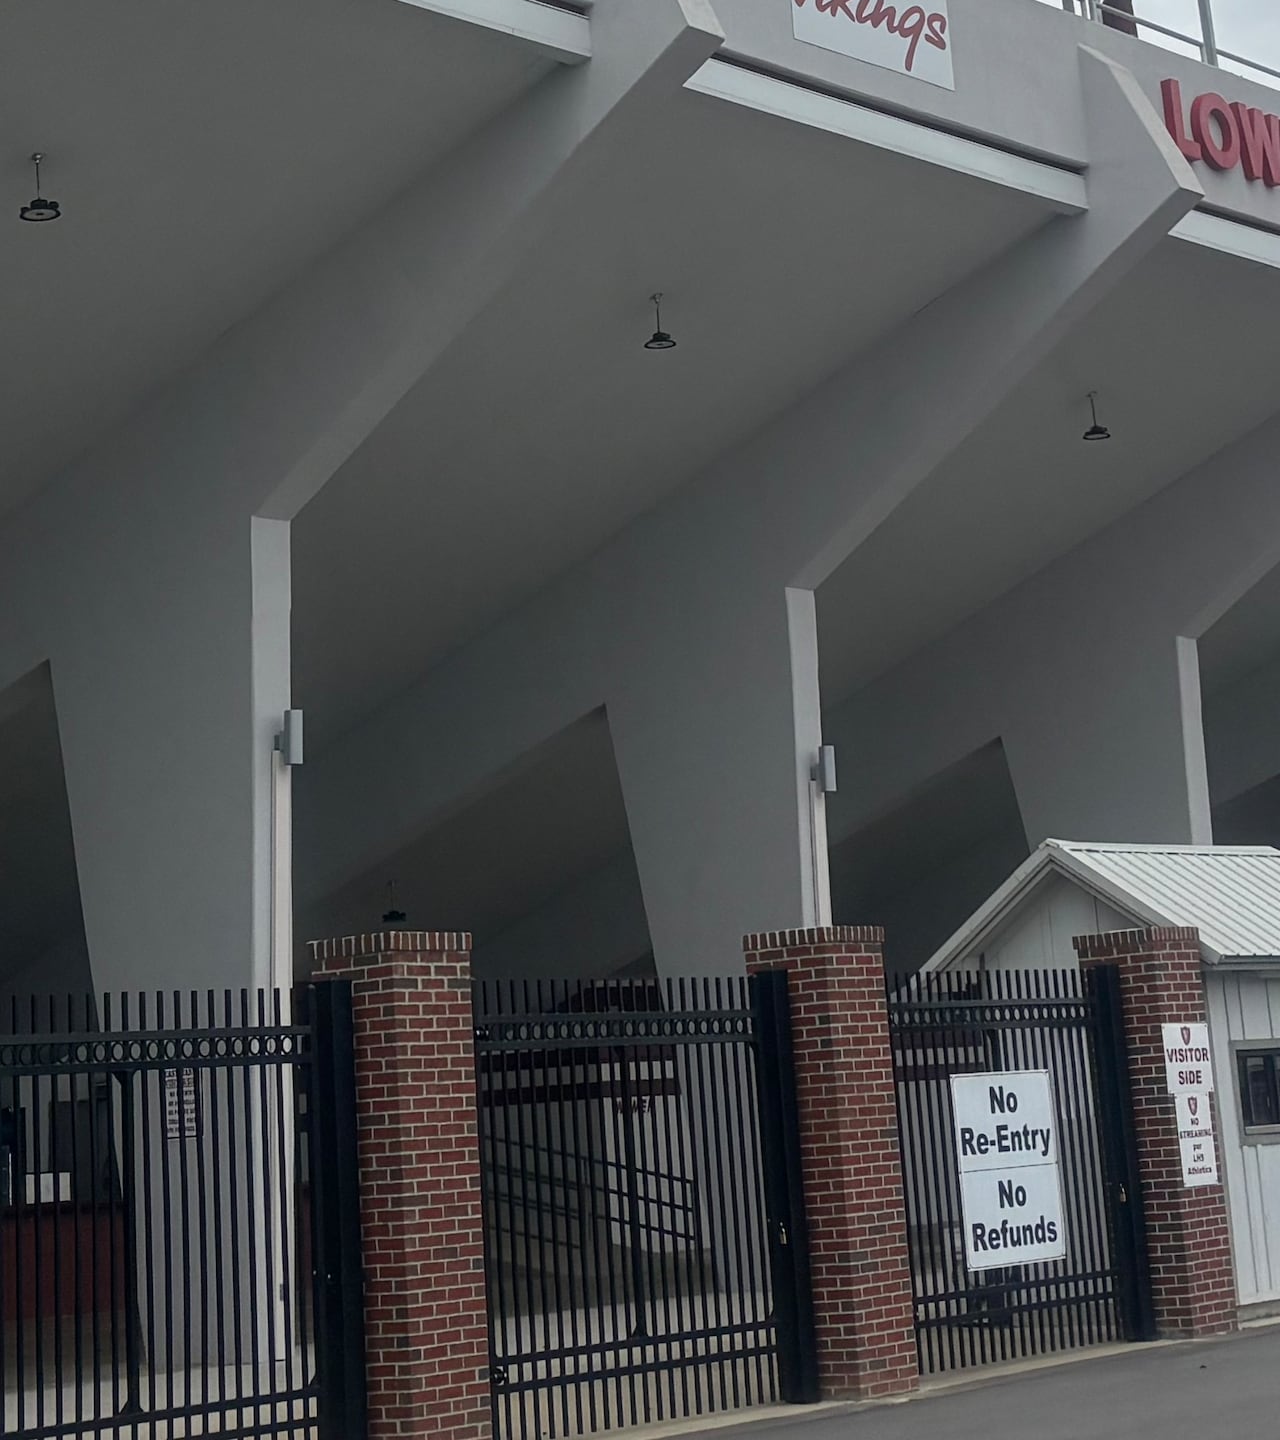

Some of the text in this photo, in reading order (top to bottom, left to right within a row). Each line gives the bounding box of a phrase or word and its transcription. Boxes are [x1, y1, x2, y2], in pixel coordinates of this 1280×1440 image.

[1166, 1047, 1209, 1063] VISITOR
[1178, 1069, 1203, 1085] SIDE
[989, 1085, 1018, 1114] No
[960, 1123, 1051, 1157] Re-Entry
[998, 1179, 1027, 1209] No
[972, 1215, 1058, 1252] Refunds
